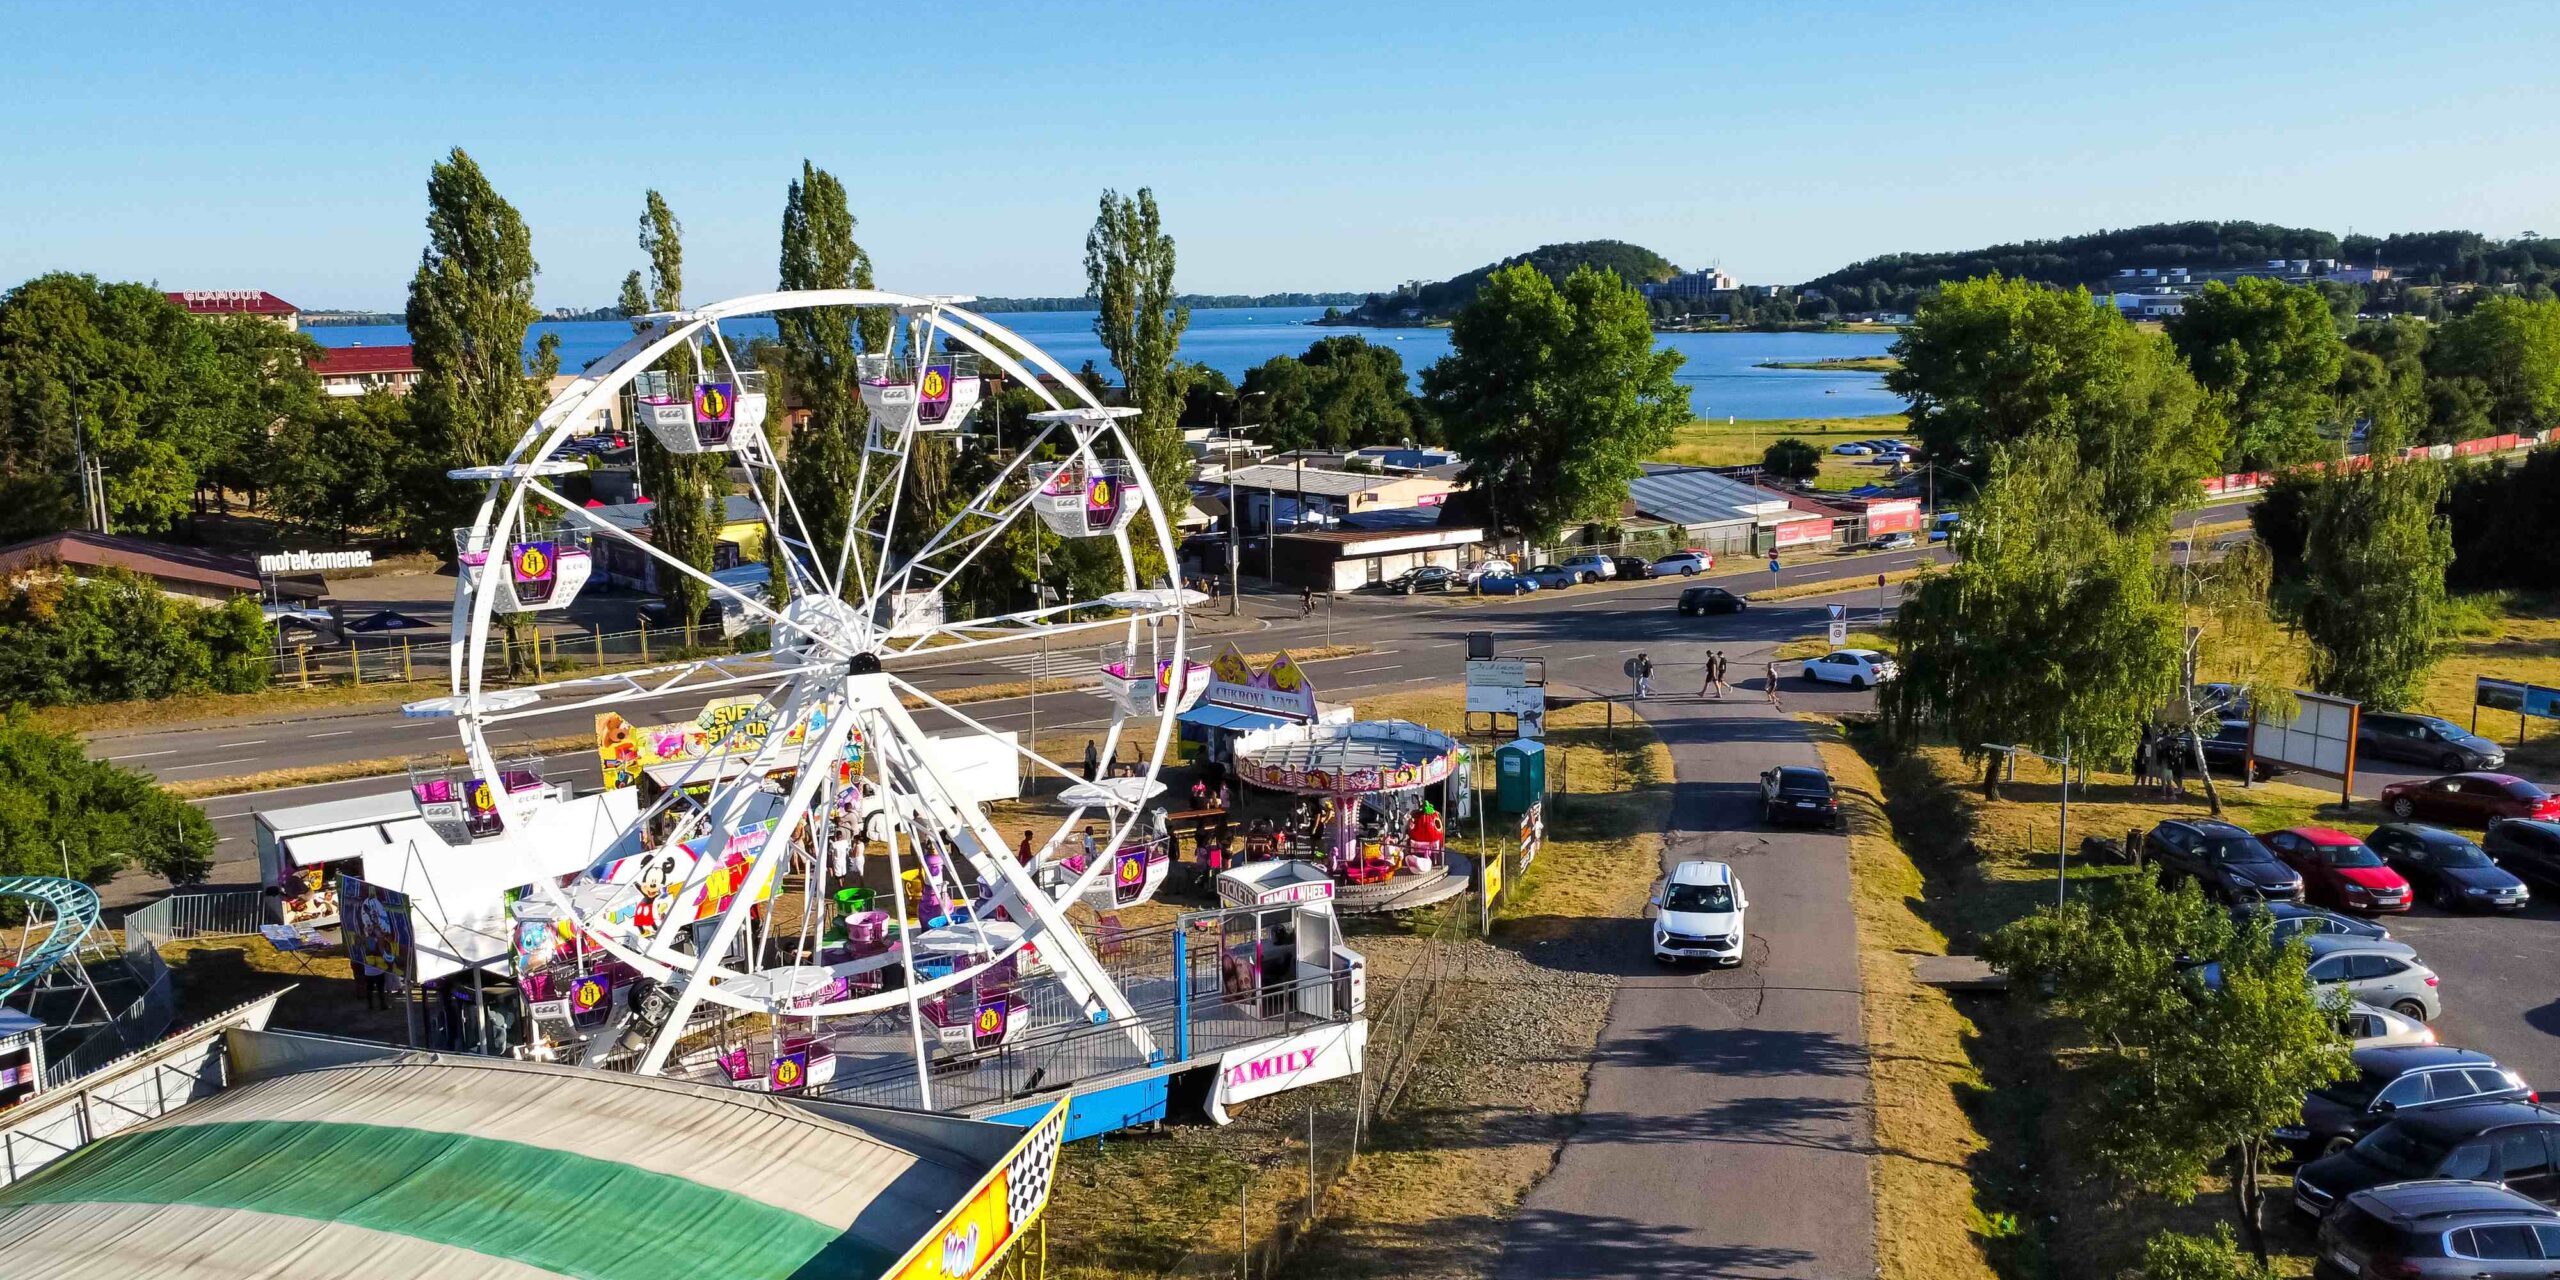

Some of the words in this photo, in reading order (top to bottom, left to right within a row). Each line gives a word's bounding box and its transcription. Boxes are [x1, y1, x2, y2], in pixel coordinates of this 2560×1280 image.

[183, 289, 262, 301] GLAMOUR
[1216, 686, 1265, 703] CUKROVÁ
[1272, 694, 1301, 709] VATA
[1220, 880, 1255, 905] TICKETS
[1263, 887, 1297, 904] FAMILY
[1297, 883, 1328, 902] WHEEL
